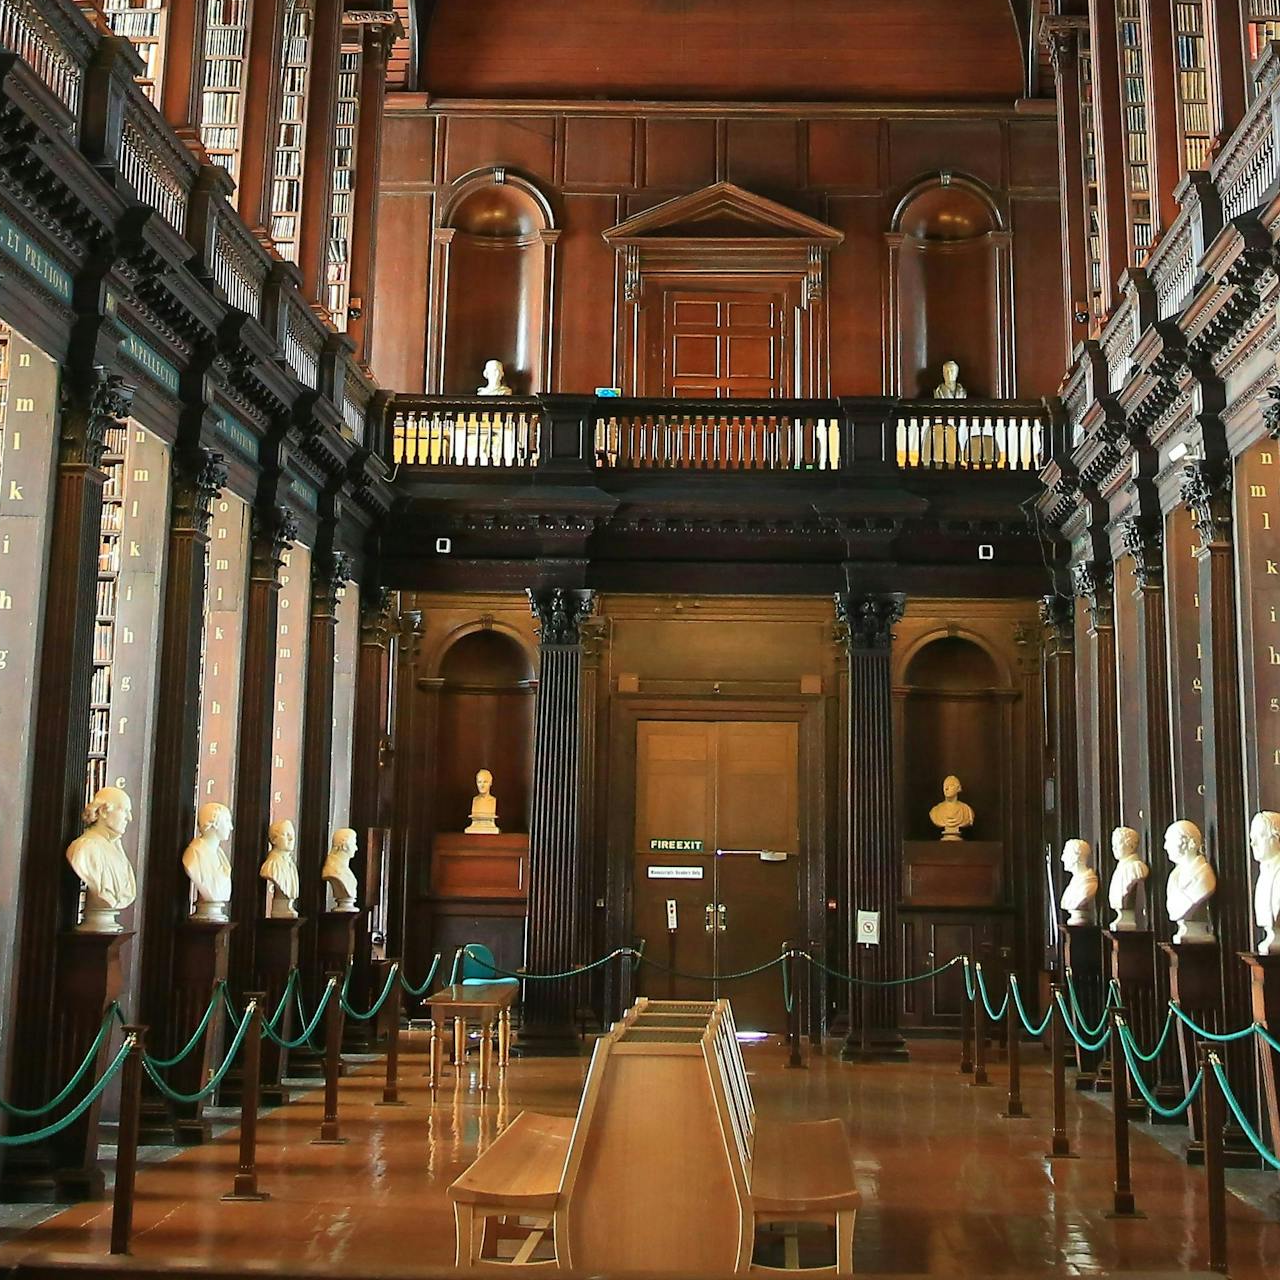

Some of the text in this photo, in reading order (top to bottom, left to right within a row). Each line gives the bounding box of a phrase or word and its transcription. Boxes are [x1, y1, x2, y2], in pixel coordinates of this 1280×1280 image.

[20, 353, 30, 366] n
[16, 398, 34, 412] m
[14, 432, 20, 449] l
[136, 431, 144, 442] n
[1260, 452, 1272, 464] n
[134, 470, 148, 481] m
[9, 481, 22, 500] k
[1250, 486, 1266, 497] m
[132, 501, 138, 517] l
[220, 502, 228, 512] o
[1263, 513, 1270, 530] l
[218, 528, 226, 538] n
[3, 535, 9, 553] i
[130, 542, 140, 556] k
[216, 560, 228, 570] m
[1266, 560, 1278, 574] k
[281, 600, 289, 608] o
[123, 628, 133, 643] h
[216, 627, 224, 639] k
[281, 625, 288, 634] n
[280, 649, 290, 657] m
[1269, 646, 1280, 664] h
[121, 676, 131, 691] g
[212, 702, 220, 714] h
[278, 701, 285, 711] k
[1271, 698, 1279, 711] g
[119, 718, 127, 734] f
[210, 742, 218, 754] g
[276, 755, 283, 767] h
[207, 780, 214, 794] f
[651, 840, 702, 850] FIRE EXIT
